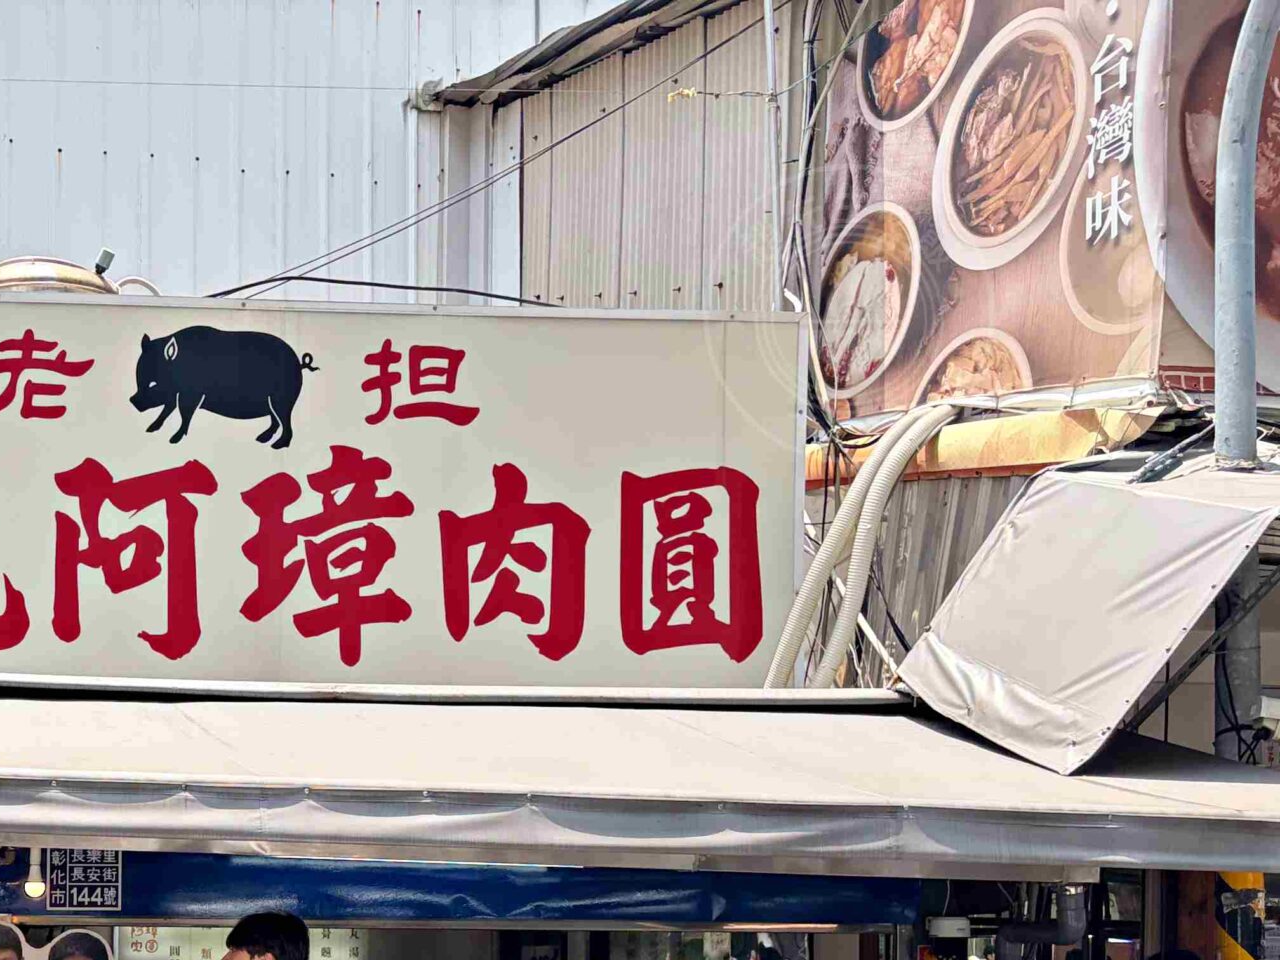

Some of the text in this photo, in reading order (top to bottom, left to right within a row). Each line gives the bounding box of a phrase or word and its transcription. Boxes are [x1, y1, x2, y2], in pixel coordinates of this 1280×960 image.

[1085, 33, 1134, 246] 台灣味
[71, 849, 117, 863] 長樂里
[51, 850, 66, 905] 彰化市
[70, 867, 117, 882] 長安街
[70, 887, 117, 906] 144號
